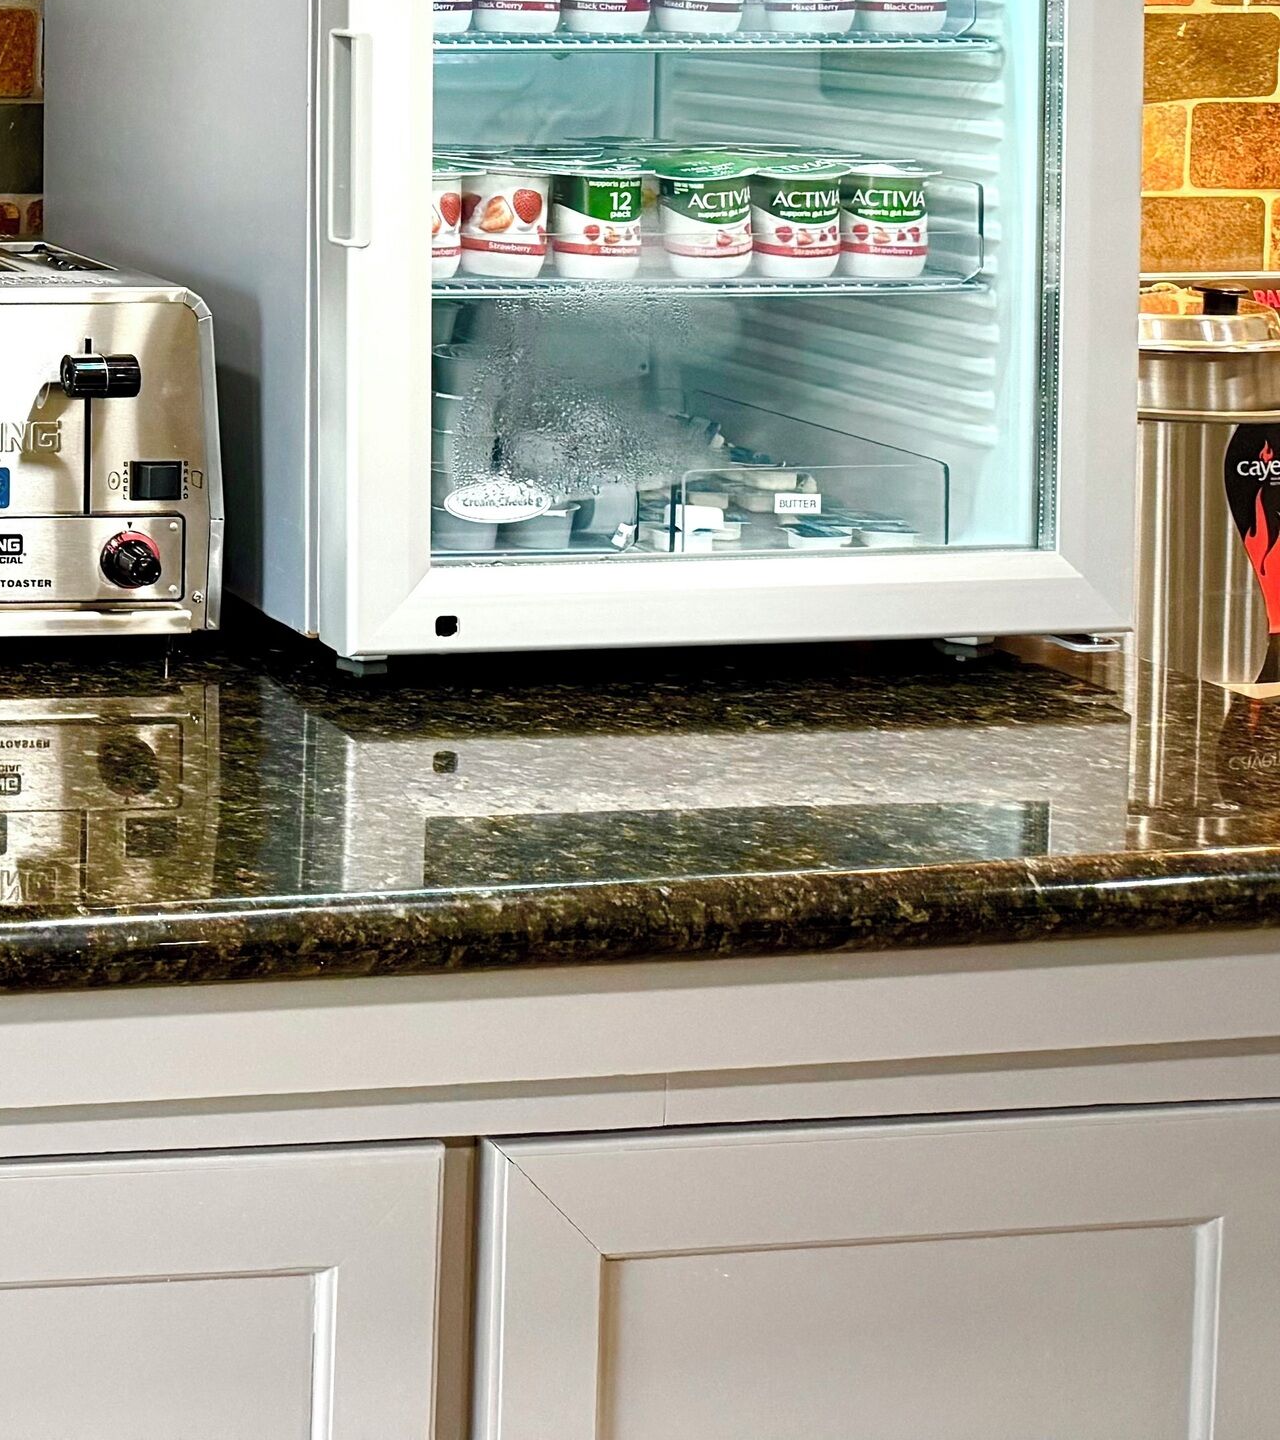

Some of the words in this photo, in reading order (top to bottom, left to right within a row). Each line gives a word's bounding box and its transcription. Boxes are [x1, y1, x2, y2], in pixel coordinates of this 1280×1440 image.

[496, 1, 523, 11] Cherry
[577, 1, 598, 10] Black
[599, 2, 627, 12] Cherry
[685, 1, 709, 11] Berry
[791, 2, 817, 11] Mixed
[817, 3, 840, 12] Berry
[883, 3, 906, 11] Black
[907, 3, 935, 12] Cherry
[609, 191, 632, 211] 12
[687, 186, 751, 210] ACTIVI
[851, 188, 926, 207] ACTIVIA
[609, 210, 632, 219] pack
[488, 241, 532, 254] Strawberry
[793, 247, 833, 256] Strawberry
[869, 246, 914, 256] Strawberry
[778, 499, 817, 509] BUTTER
[0, 579, 53, 588] TOASTER
